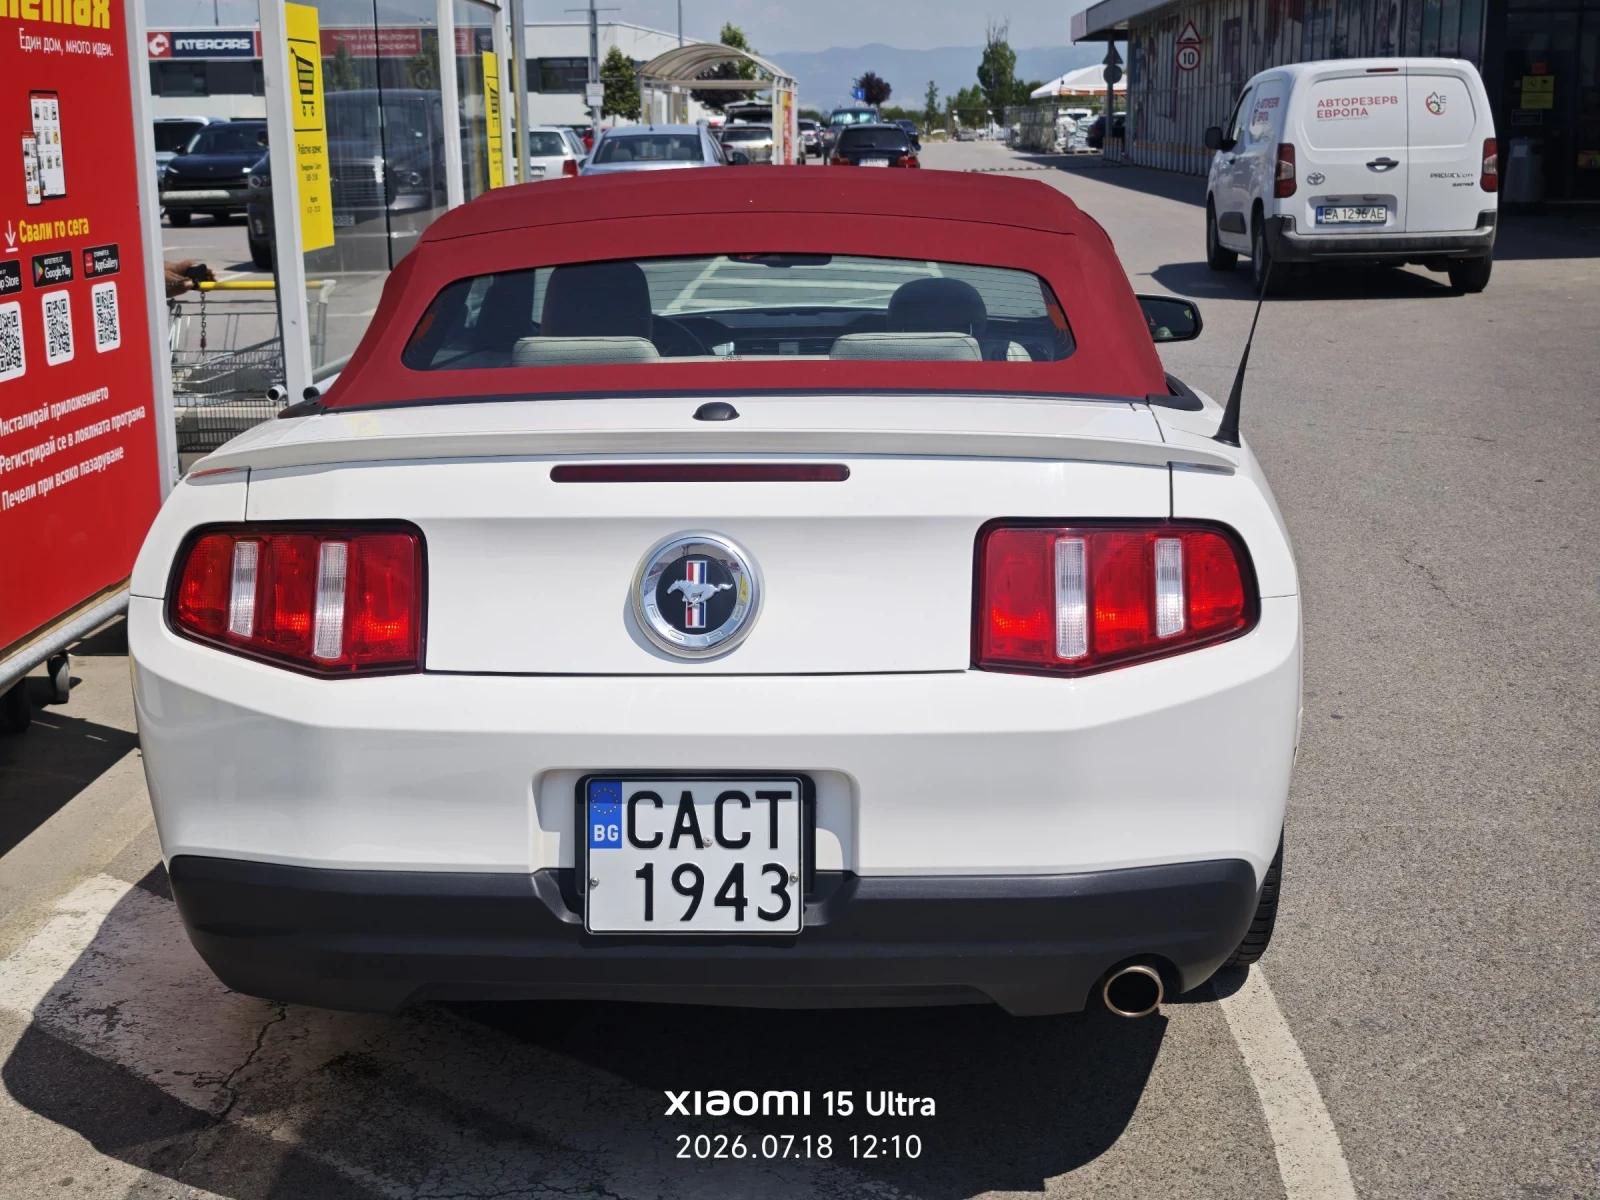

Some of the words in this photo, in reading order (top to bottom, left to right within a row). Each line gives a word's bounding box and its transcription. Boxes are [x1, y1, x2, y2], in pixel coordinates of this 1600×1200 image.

[19, 27, 42, 53] Един
[43, 37, 64, 56] дом,
[65, 39, 91, 55] много
[92, 42, 114, 58] идеи.
[175, 38, 251, 50] INTERCARS
[1183, 51, 1195, 65] 10
[1317, 95, 1398, 108] АВТОРЕЗЕРВ
[1316, 107, 1369, 119] ЕВРОПА
[1324, 208, 1339, 220] EA
[1342, 208, 1368, 220] 1296
[1369, 207, 1385, 219] AE
[19, 219, 52, 243] Свали
[54, 222, 66, 238] го
[67, 217, 90, 236] сега
[44, 266, 61, 280] Google
[61, 264, 71, 278] Play
[5, 276, 19, 288] Store
[50, 386, 109, 421] приложението
[0, 435, 55, 475] Регистрирай
[57, 436, 67, 451] се
[68, 433, 73, 447] в
[75, 419, 111, 444] лоялната
[111, 405, 145, 432] програма
[2, 483, 36, 511] Печели
[37, 475, 54, 497] при
[55, 465, 79, 486] всяко
[79, 446, 124, 476] пазаруване
[626, 790, 792, 849] CACT
[593, 824, 619, 841] BG
[635, 862, 792, 922] 1943
